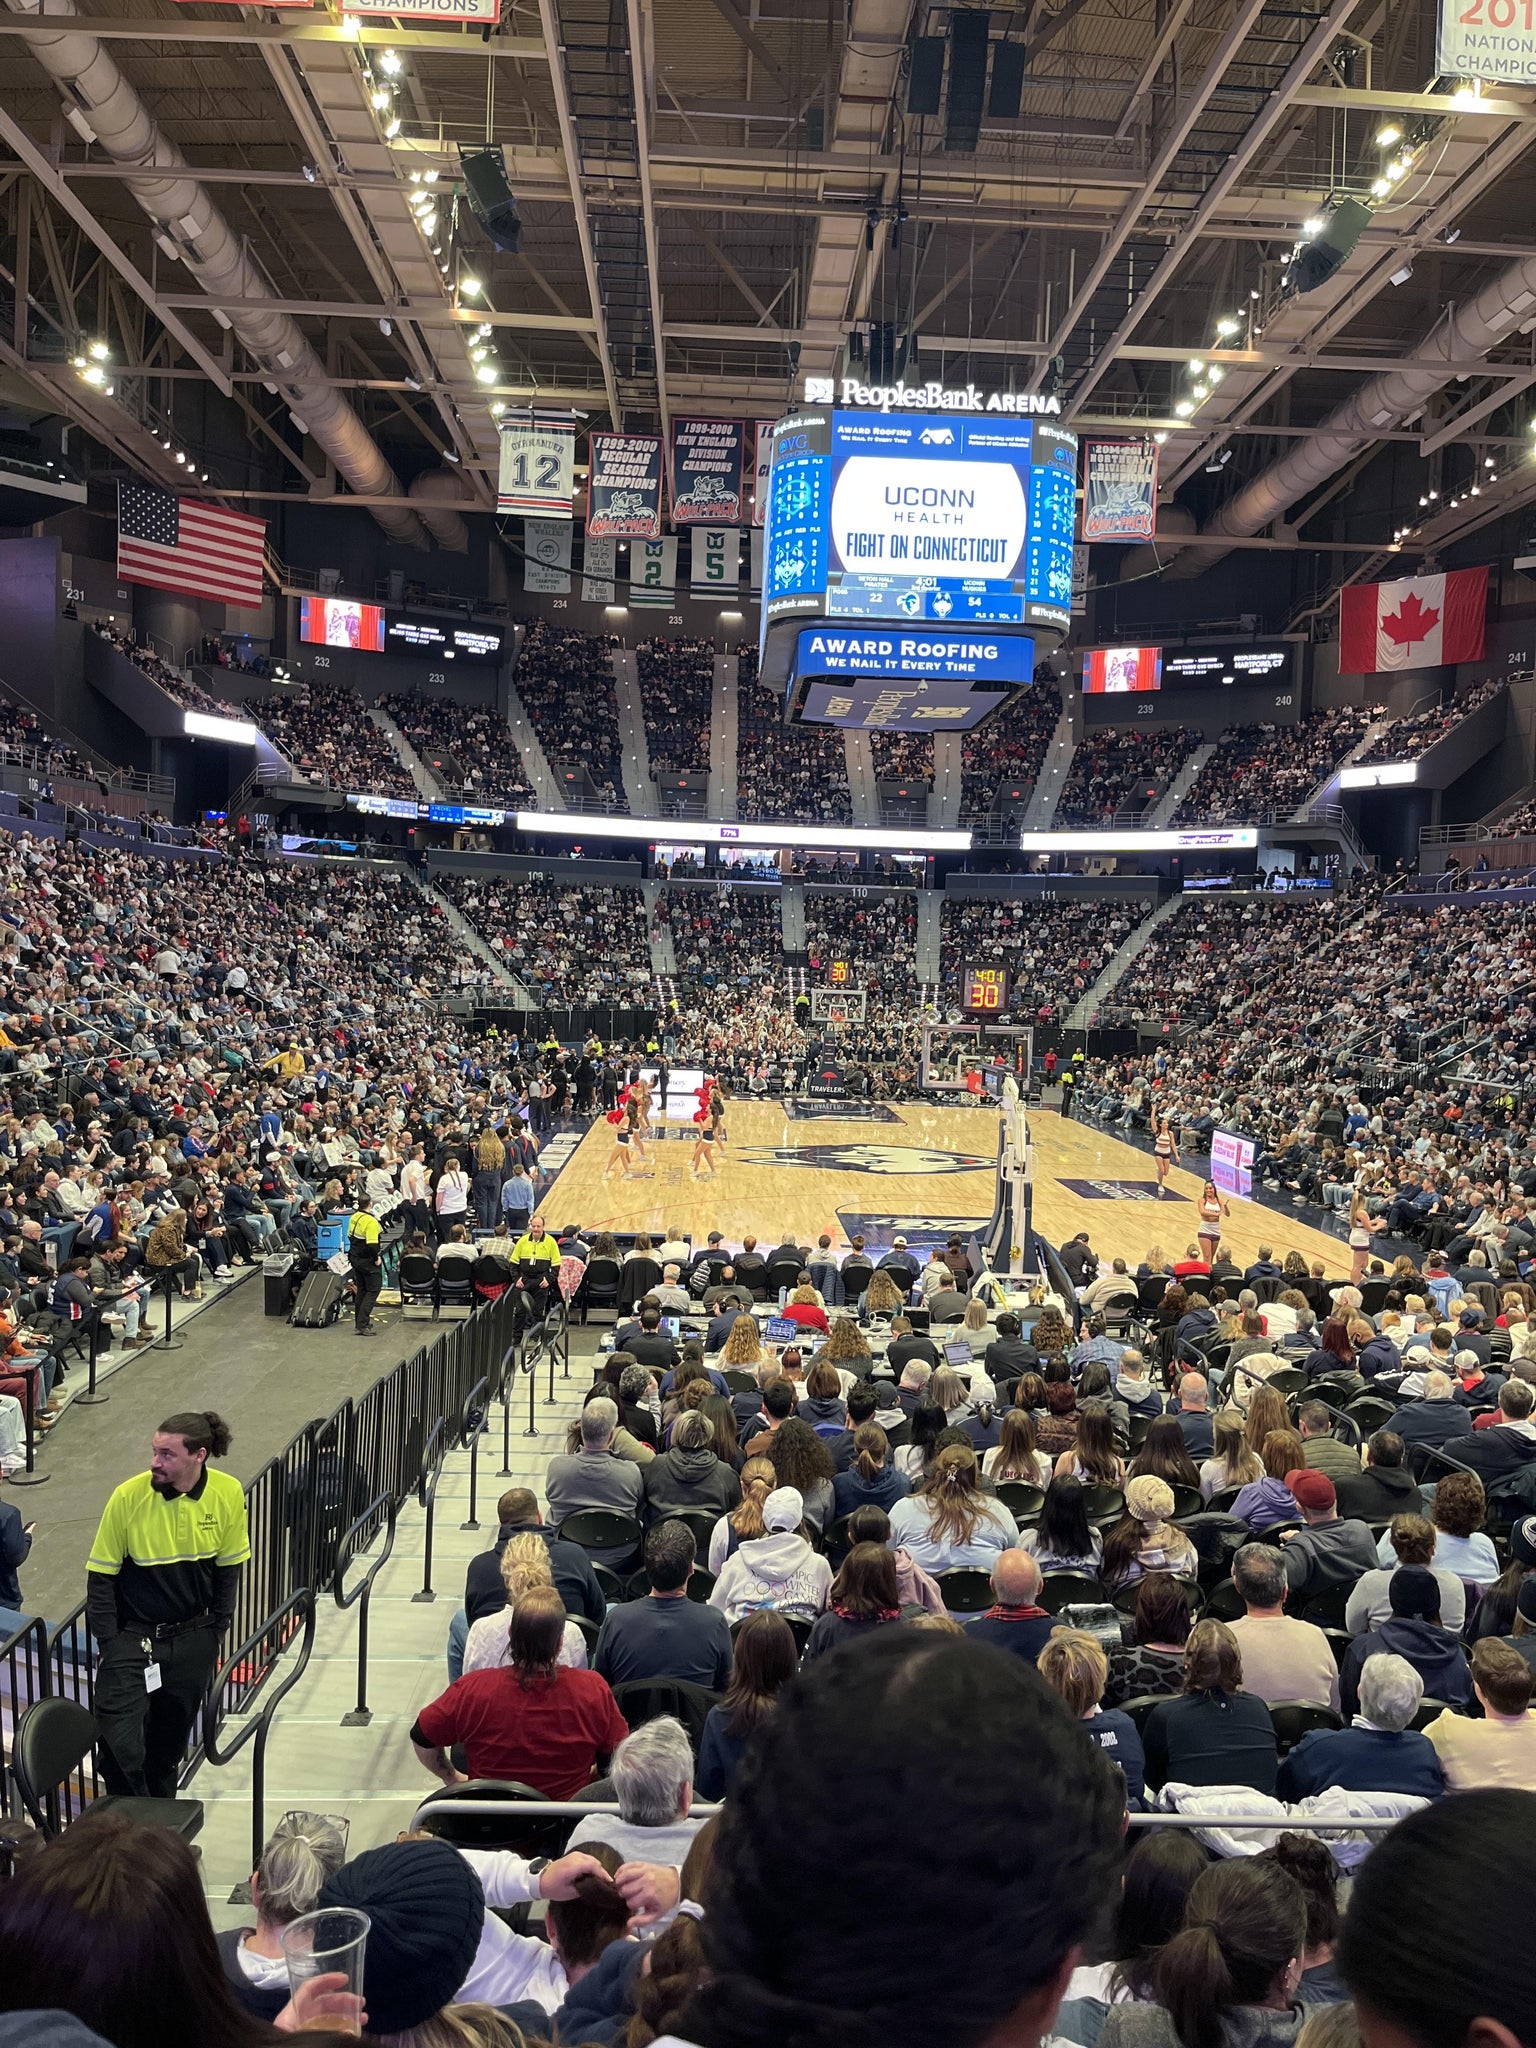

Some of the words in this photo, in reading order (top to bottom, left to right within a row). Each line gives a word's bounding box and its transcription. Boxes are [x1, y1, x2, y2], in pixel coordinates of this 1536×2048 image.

[1464, 33, 1536, 53] NATION
[841, 379, 984, 413] PeoplesBank
[986, 393, 1061, 414] ARENA
[685, 423, 733, 435] 1999-2000
[837, 425, 871, 435] AWARD
[872, 427, 912, 437] ROOFING
[595, 438, 658, 452] 1999-2000
[676, 435, 697, 445] NEW
[697, 436, 737, 447] ENGLAND
[600, 450, 651, 464] REGULAR
[688, 448, 728, 459] DIVISION
[1090, 454, 1153, 464] NORTHEAST
[512, 453, 560, 490] 12
[603, 463, 648, 477] SEASON
[682, 460, 733, 472] CHAMPIONS
[800, 472, 806, 480] 2
[815, 471, 819, 479] 1
[1090, 472, 1152, 482] CHAMPIONS
[592, 475, 658, 490] CHAMPIONS
[1035, 481, 1041, 489] 2
[885, 486, 975, 508] UCONN
[894, 511, 964, 525] HEALTH
[1033, 520, 1042, 528] 10
[846, 533, 885, 558] FIGHT
[890, 534, 908, 559] ON
[914, 536, 1008, 563] CONNECTICUT
[706, 553, 724, 580] 5
[645, 561, 661, 588] 2
[915, 576, 938, 587] 4:01
[1030, 578, 1038, 586] 21
[66, 588, 84, 601] 231
[869, 593, 883, 603] 22
[553, 600, 567, 608] 234
[967, 597, 982, 606] 54
[668, 616, 683, 625] 235
[489, 642, 499, 650] CT
[810, 637, 893, 655] AWARD
[900, 640, 999, 660] ROOFING
[314, 656, 330, 668] 232
[1273, 659, 1283, 667] CT
[1508, 652, 1526, 664] 241
[825, 657, 846, 667] WE
[850, 658, 881, 668] NAIL
[885, 659, 898, 669] IT
[901, 660, 941, 671] EVERY
[945, 662, 976, 672] TIME
[429, 673, 445, 683] 233
[1275, 696, 1292, 706] 240
[1138, 705, 1153, 714] 239
[28, 777, 39, 792] 106
[254, 813, 269, 825] 107
[1325, 855, 1339, 865] 112
[716, 883, 732, 893] 109
[851, 888, 868, 898] 110
[1040, 890, 1056, 900] 111
[833, 961, 848, 969] 4:01
[832, 969, 846, 980] 30
[975, 969, 1003, 983] 4:01
[972, 984, 999, 1008] 30
[810, 1085, 846, 1093] TRAVELERS
[785, 1579, 821, 1595] WINTER
[785, 1590, 819, 1606] GAMES
